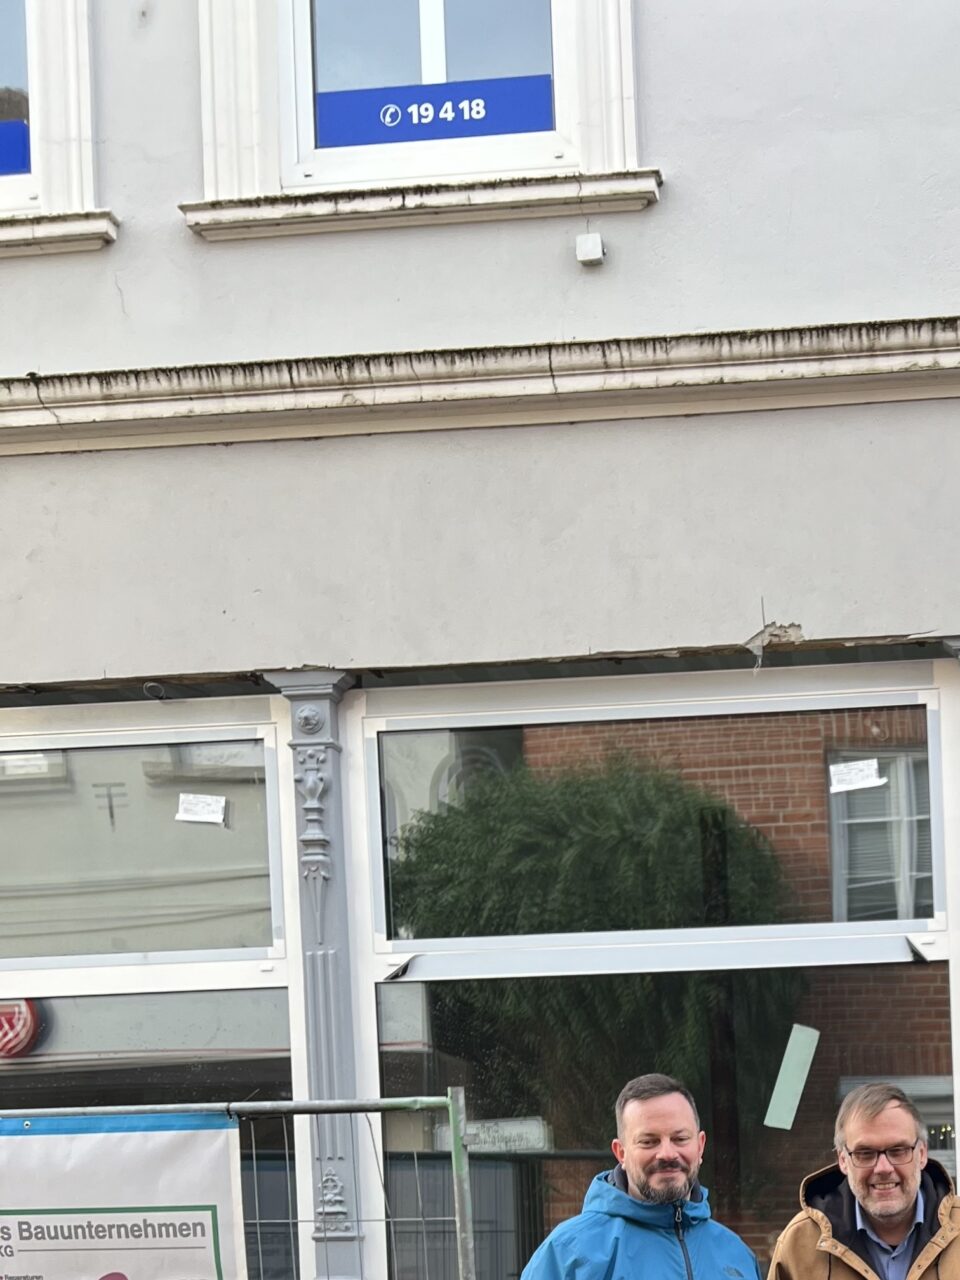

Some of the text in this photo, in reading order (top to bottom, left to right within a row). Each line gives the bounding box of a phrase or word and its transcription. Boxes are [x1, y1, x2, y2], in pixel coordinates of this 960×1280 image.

[407, 98, 486, 124] 19 4 18
[17, 1218, 207, 1241] Bauunternehmen
